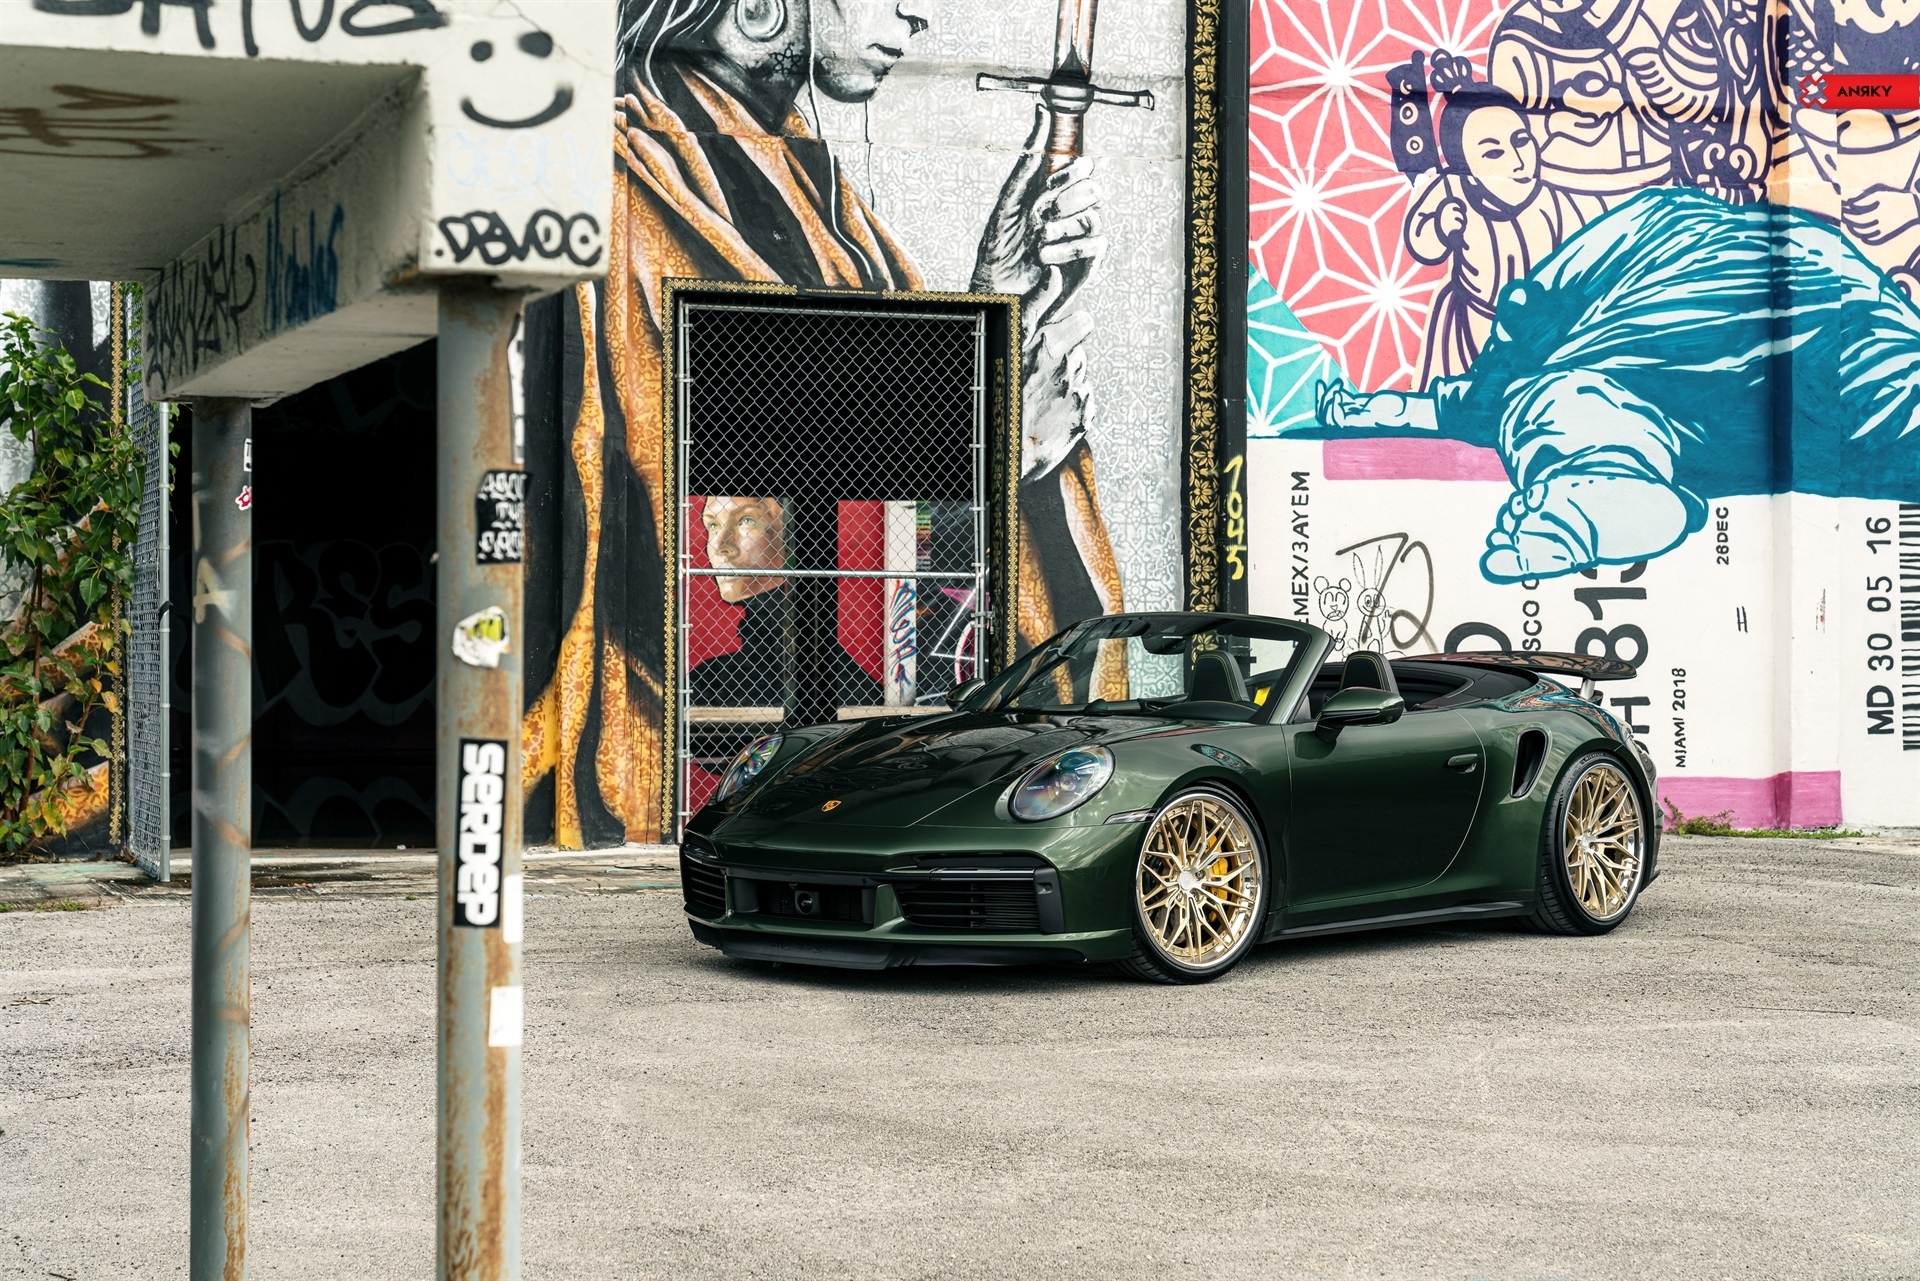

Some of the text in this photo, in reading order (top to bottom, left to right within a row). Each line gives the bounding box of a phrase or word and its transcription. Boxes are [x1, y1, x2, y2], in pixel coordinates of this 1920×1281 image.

[1671, 667, 1687, 711] 2018
[1865, 516, 1895, 735] MD 30 05 16
